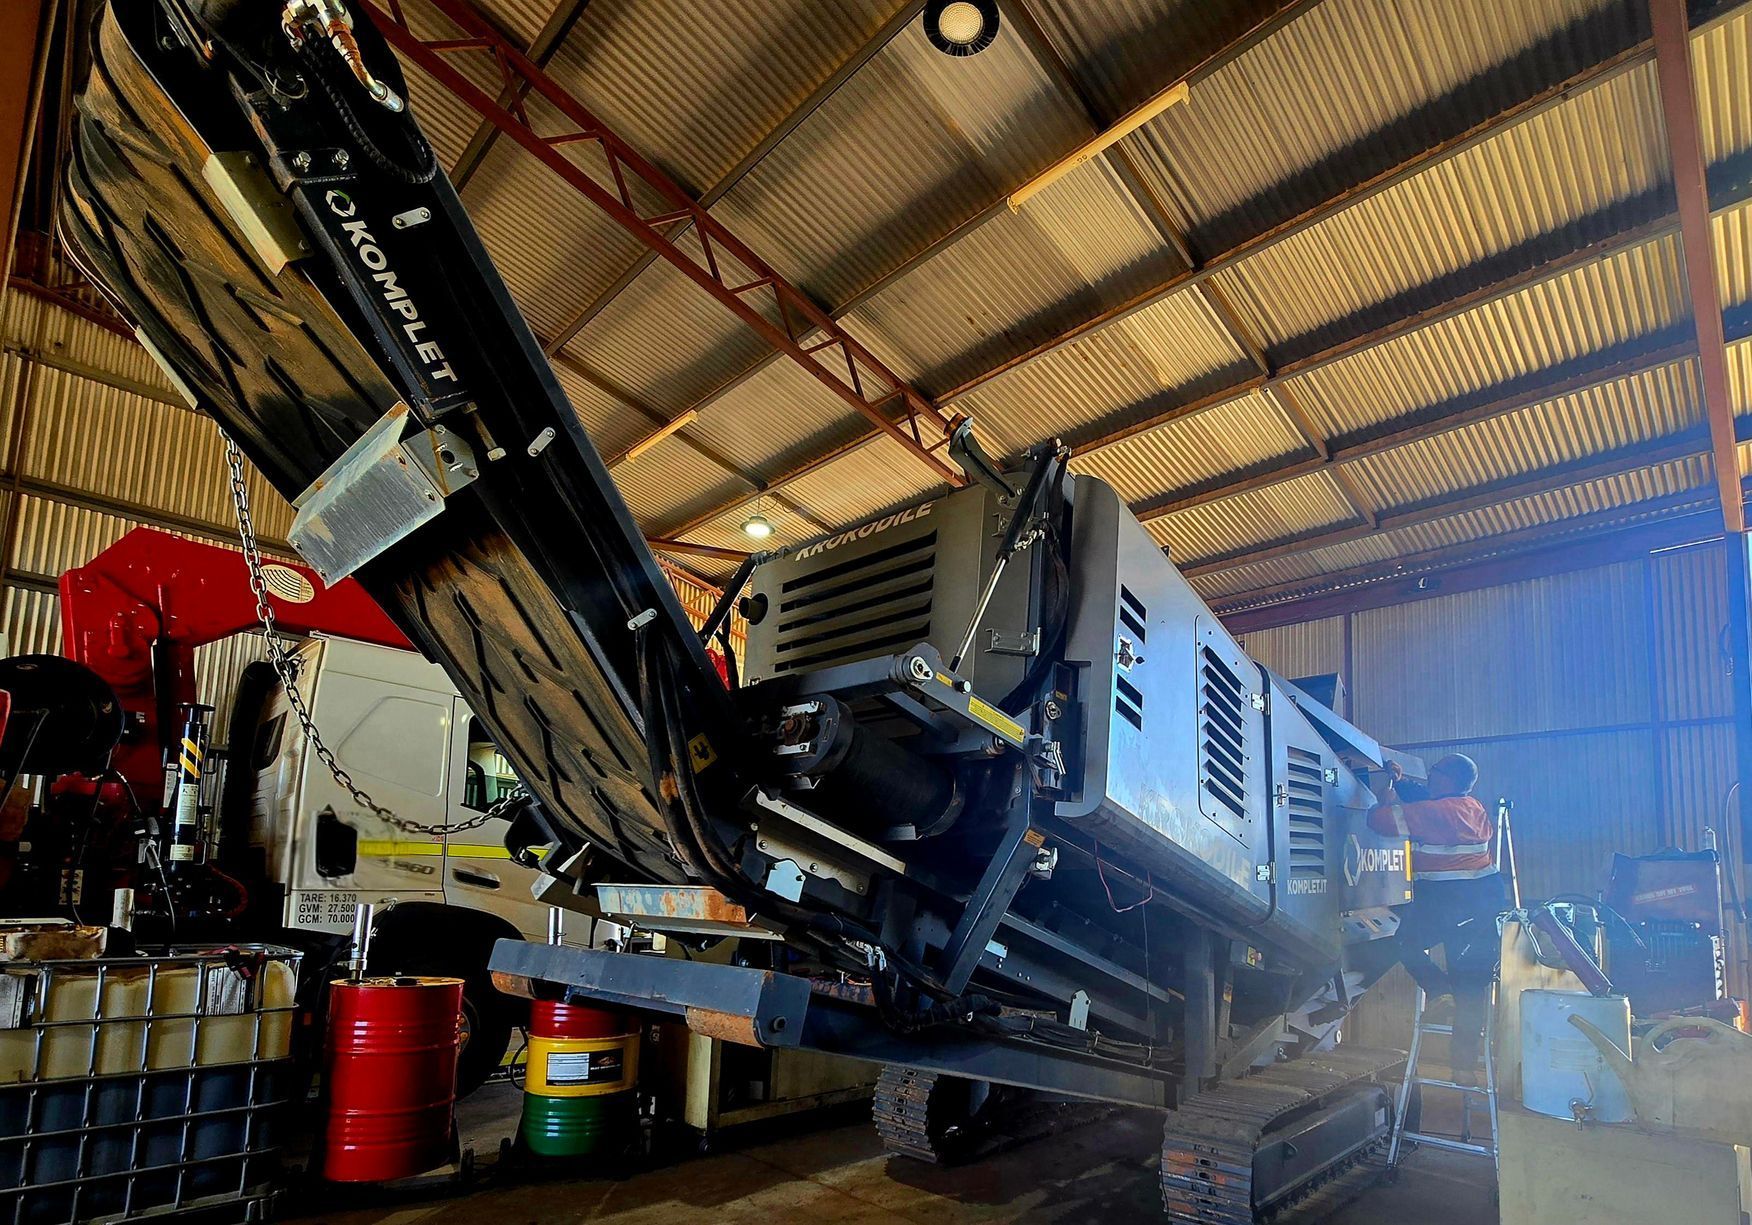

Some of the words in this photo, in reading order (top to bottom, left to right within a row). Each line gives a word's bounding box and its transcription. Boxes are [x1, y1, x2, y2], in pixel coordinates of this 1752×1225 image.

[341, 220, 458, 382] KOMPLET
[1360, 848, 1405, 872] KOMPLET
[299, 893, 327, 903] TARE:
[329, 893, 357, 903] 16.370
[298, 903, 323, 913] GVM:
[327, 903, 356, 913] 27.500
[297, 914, 323, 924] GCM:
[327, 914, 355, 924] 70.000
